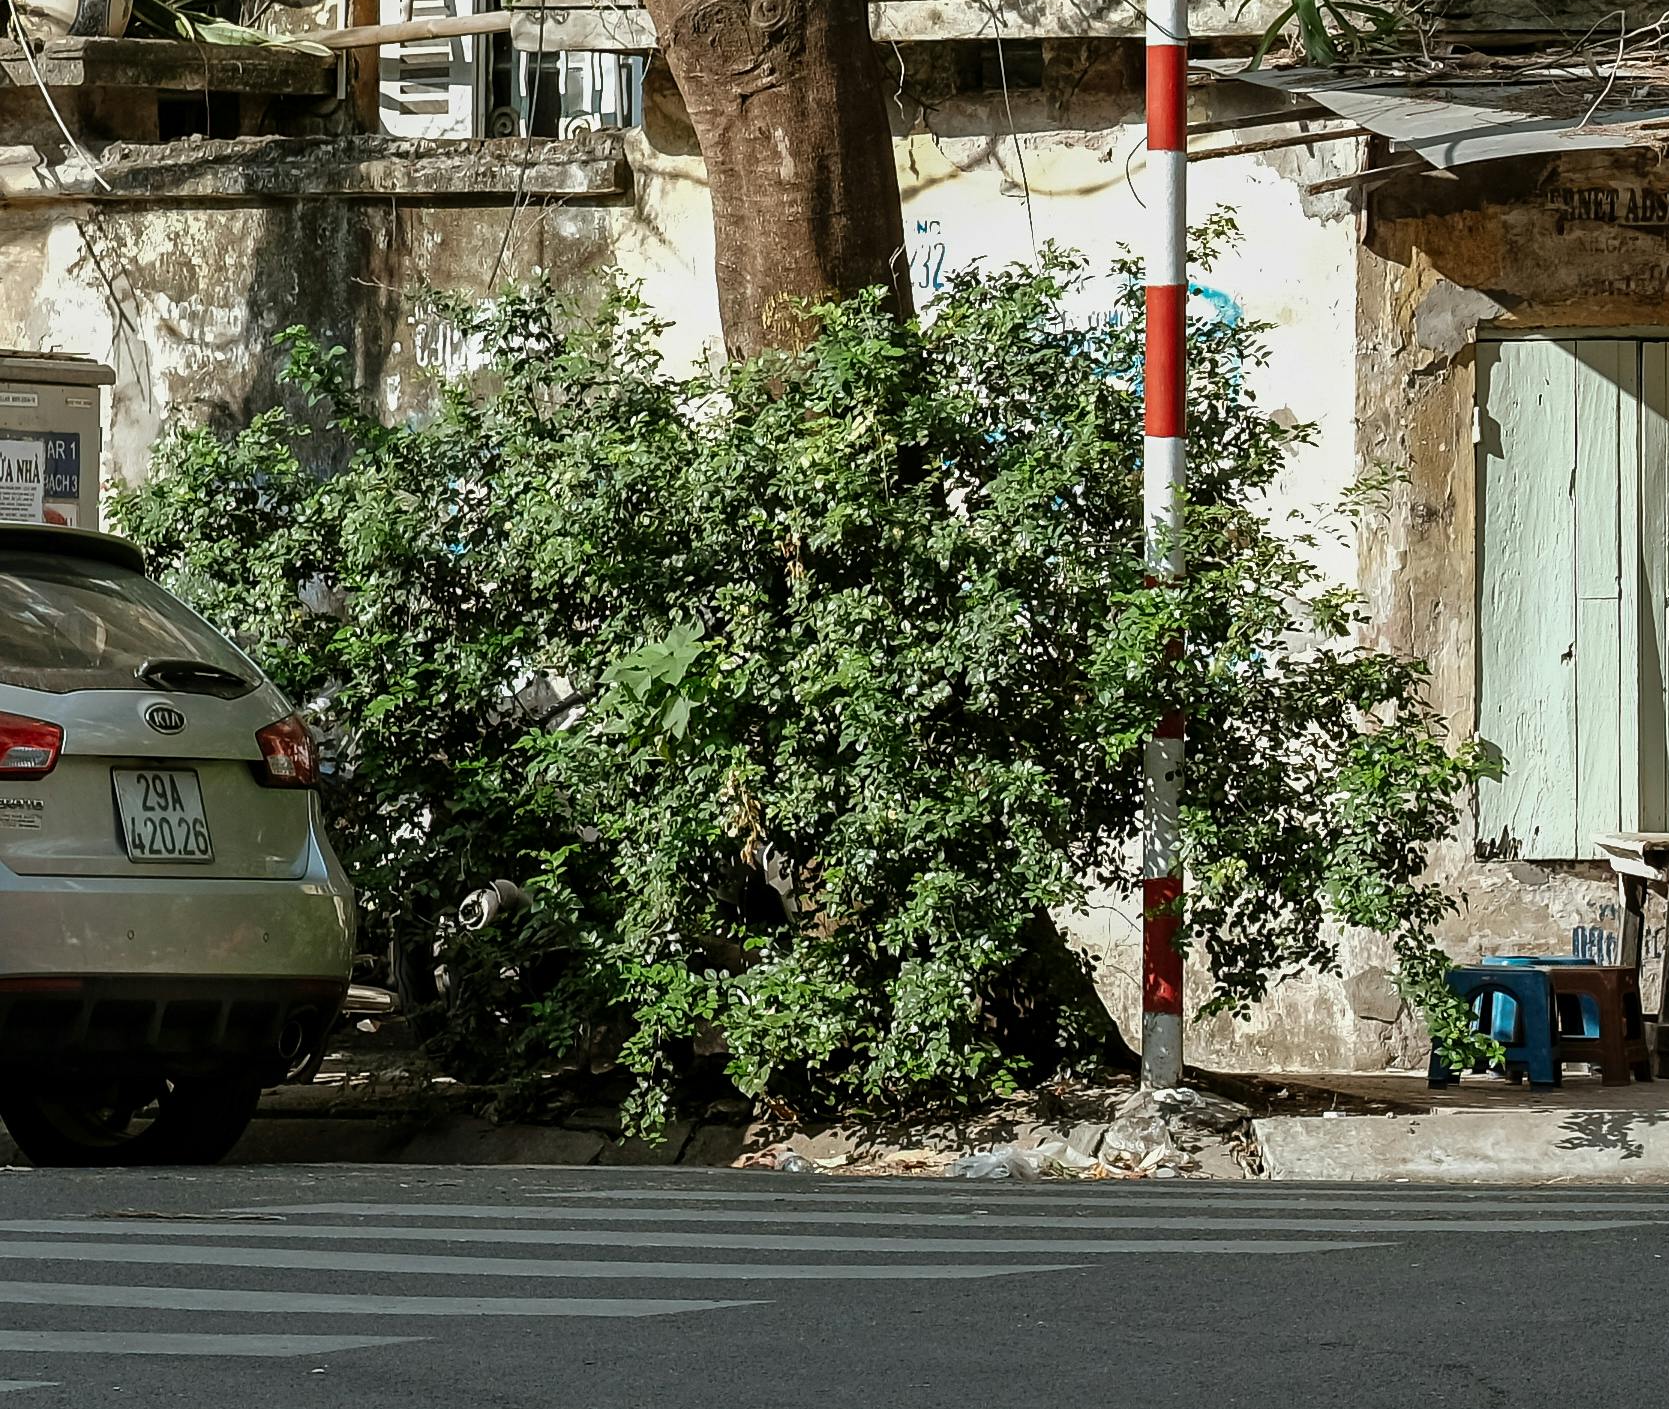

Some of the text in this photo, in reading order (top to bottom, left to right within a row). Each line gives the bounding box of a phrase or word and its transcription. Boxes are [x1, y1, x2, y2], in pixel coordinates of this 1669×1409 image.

[17, 452, 41, 484] NHÀ
[154, 711, 181, 727] KIA
[136, 772, 185, 813] 29A
[131, 816, 209, 856] 420.26
